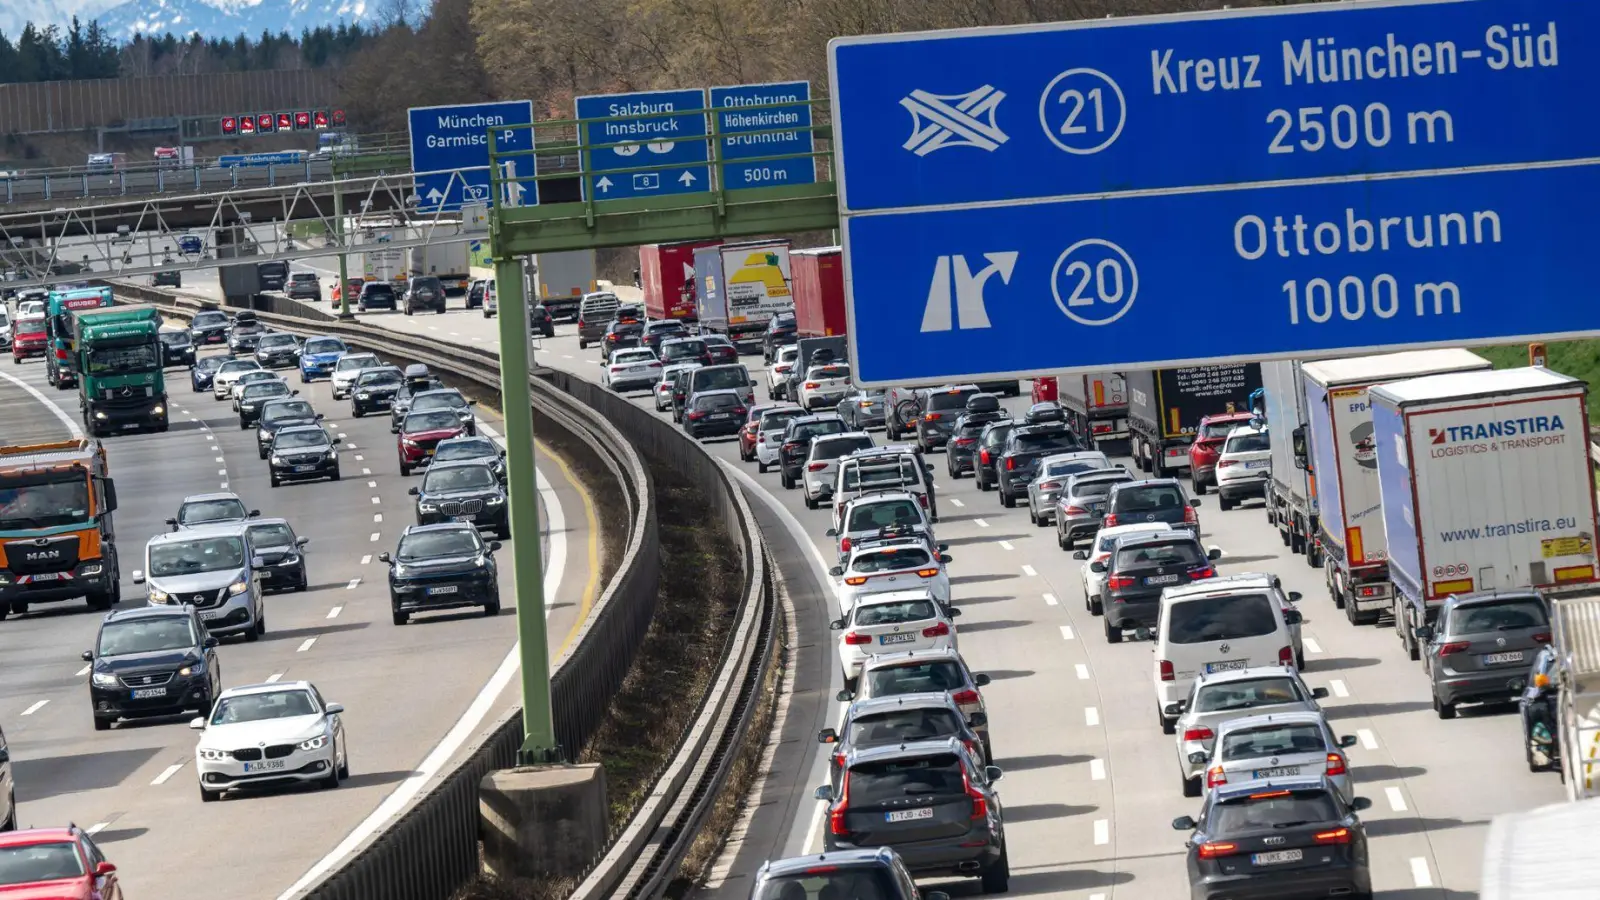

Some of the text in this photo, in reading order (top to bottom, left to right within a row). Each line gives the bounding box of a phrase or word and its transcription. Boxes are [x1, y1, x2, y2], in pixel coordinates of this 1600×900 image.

[1151, 22, 1559, 95] Kreuz München-Süd
[609, 102, 674, 117] Salzburg
[725, 111, 798, 127] Höhenkirchen
[1059, 88, 1105, 135] 21
[438, 114, 503, 128] München
[606, 115, 678, 135] Innsbruck
[1266, 102, 1454, 154] 2500 m
[426, 130, 517, 148] Garmisc-P.
[643, 176, 650, 187] 8
[744, 168, 787, 182] 500 m
[1234, 208, 1502, 260] Ottobrunn
[1067, 259, 1124, 306] 20
[68, 300, 97, 308] GRUBER
[1282, 273, 1461, 324] 1000 m
[1447, 414, 1565, 442] TRANSTIRA
[1431, 434, 1565, 459] LOGISTICS & TRANSPORT
[1440, 516, 1577, 543] www.transtira.eu
[26, 550, 60, 560] MAN
